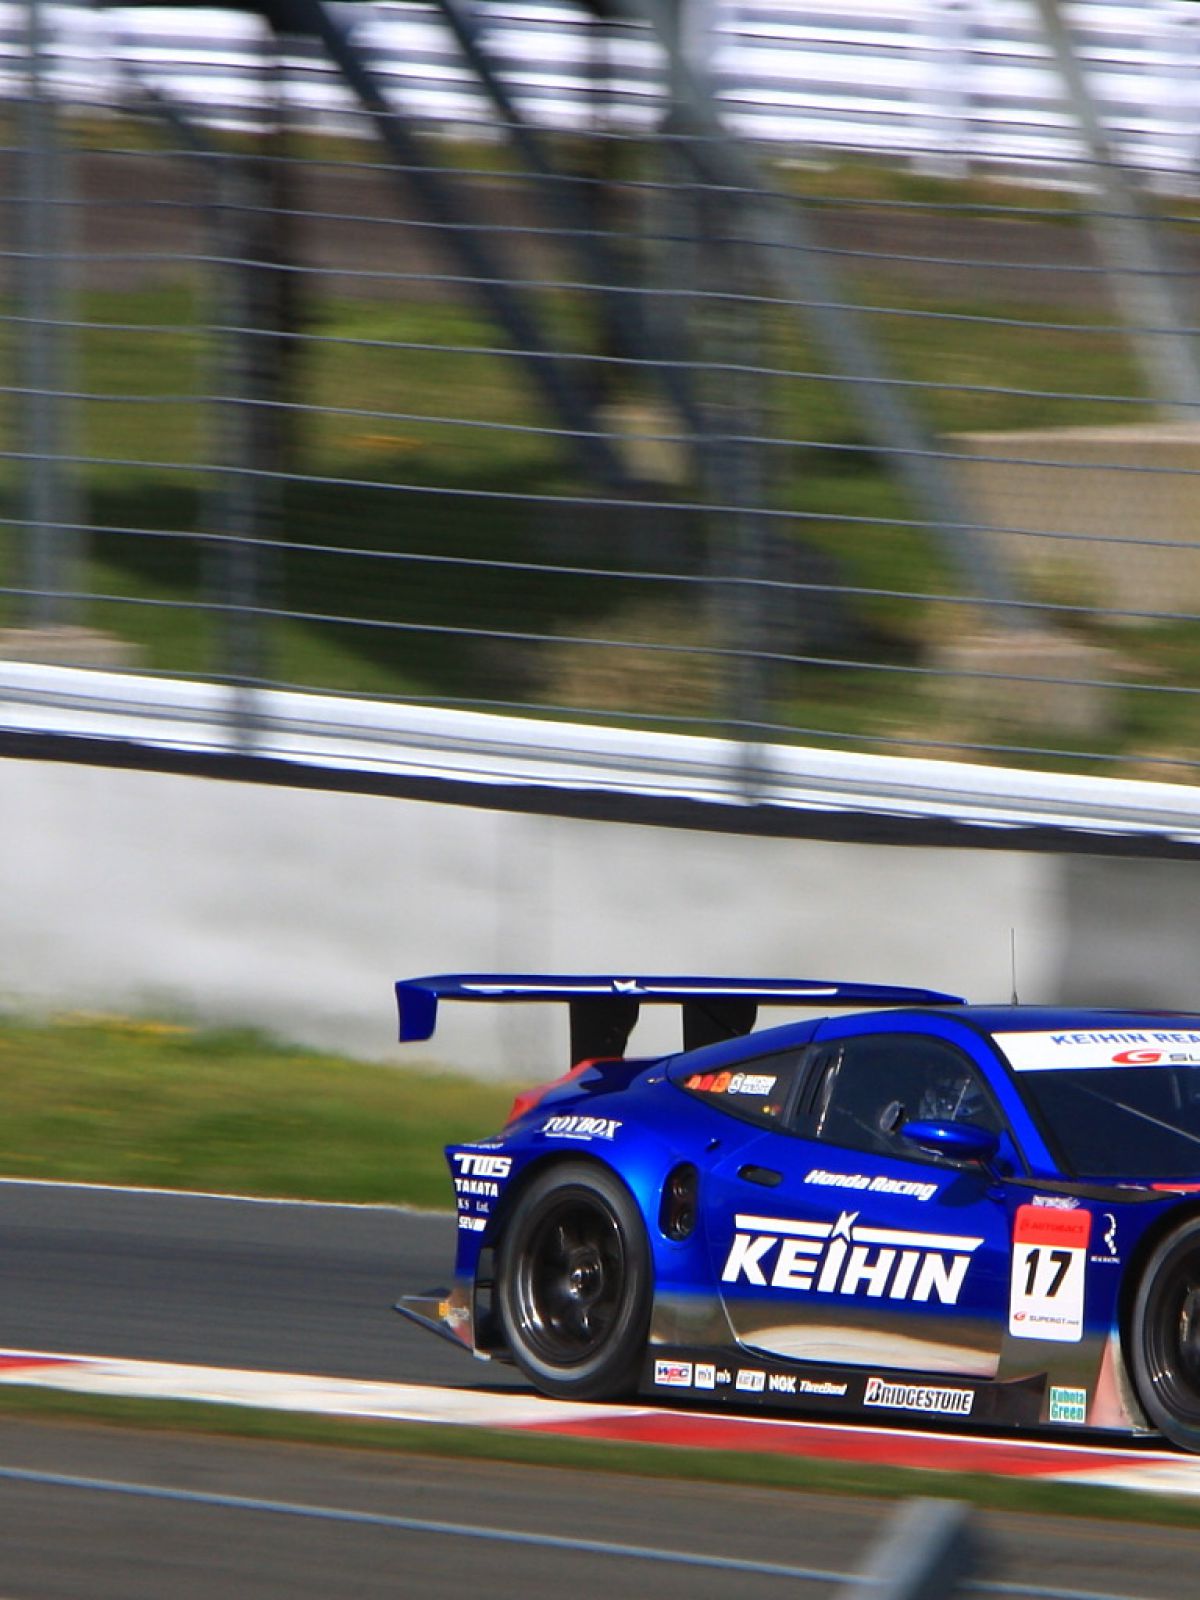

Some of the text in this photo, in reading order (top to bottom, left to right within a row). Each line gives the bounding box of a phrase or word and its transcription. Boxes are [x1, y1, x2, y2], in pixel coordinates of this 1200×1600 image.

[1049, 1032, 1148, 1046] KEIHIN
[453, 1152, 512, 1179] TWS
[454, 1177, 499, 1198] TAKATA
[803, 1169, 939, 1201] Honda Racing
[721, 1230, 971, 1304] KEIHIN
[1024, 1246, 1073, 1299] 17
[768, 1374, 797, 1394] NGK
[865, 1380, 973, 1412] BRIDGESTONE
[1051, 1403, 1084, 1421] Green
